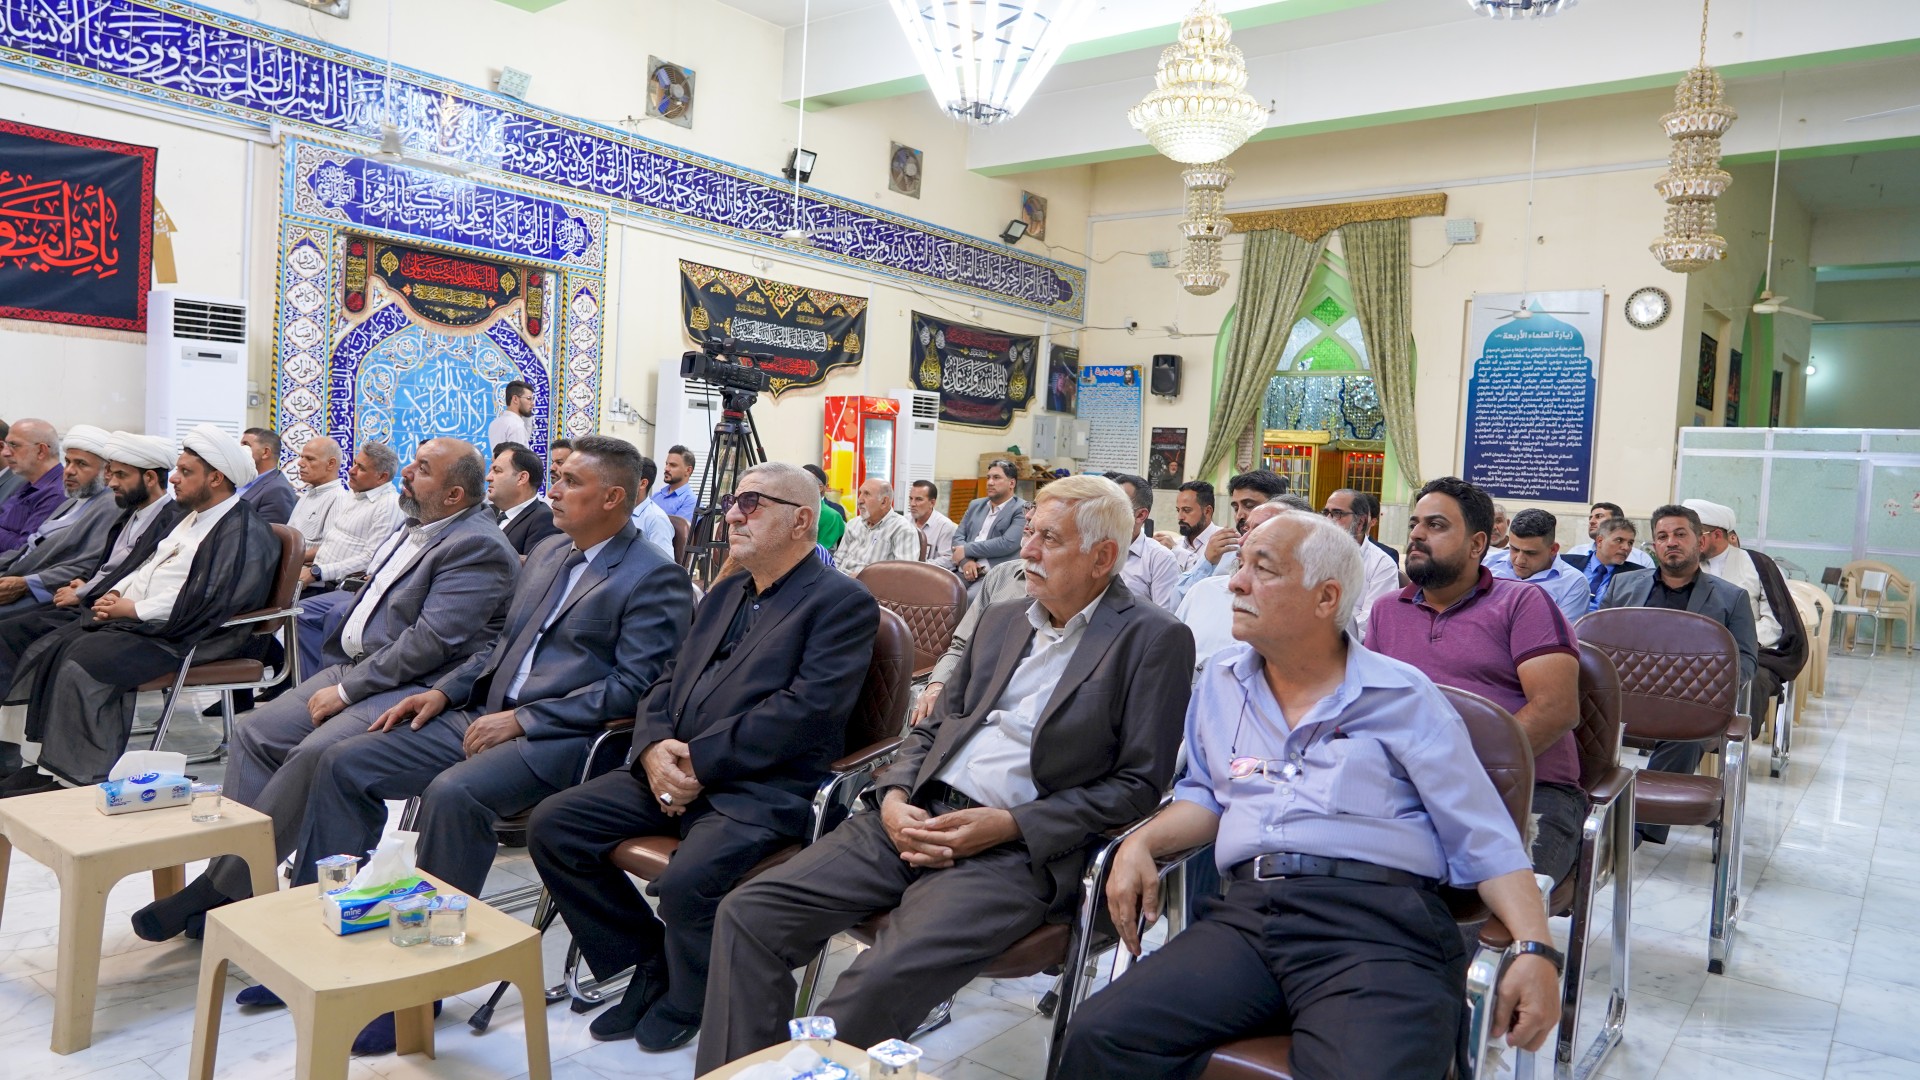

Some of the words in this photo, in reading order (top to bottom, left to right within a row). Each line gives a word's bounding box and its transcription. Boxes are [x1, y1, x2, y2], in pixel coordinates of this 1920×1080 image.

[1503, 330, 1527, 340] الأربعة
[1528, 331, 1553, 339] العلماء
[1554, 331, 1573, 340] زيارة
[291, 359, 317, 379] الجواد
